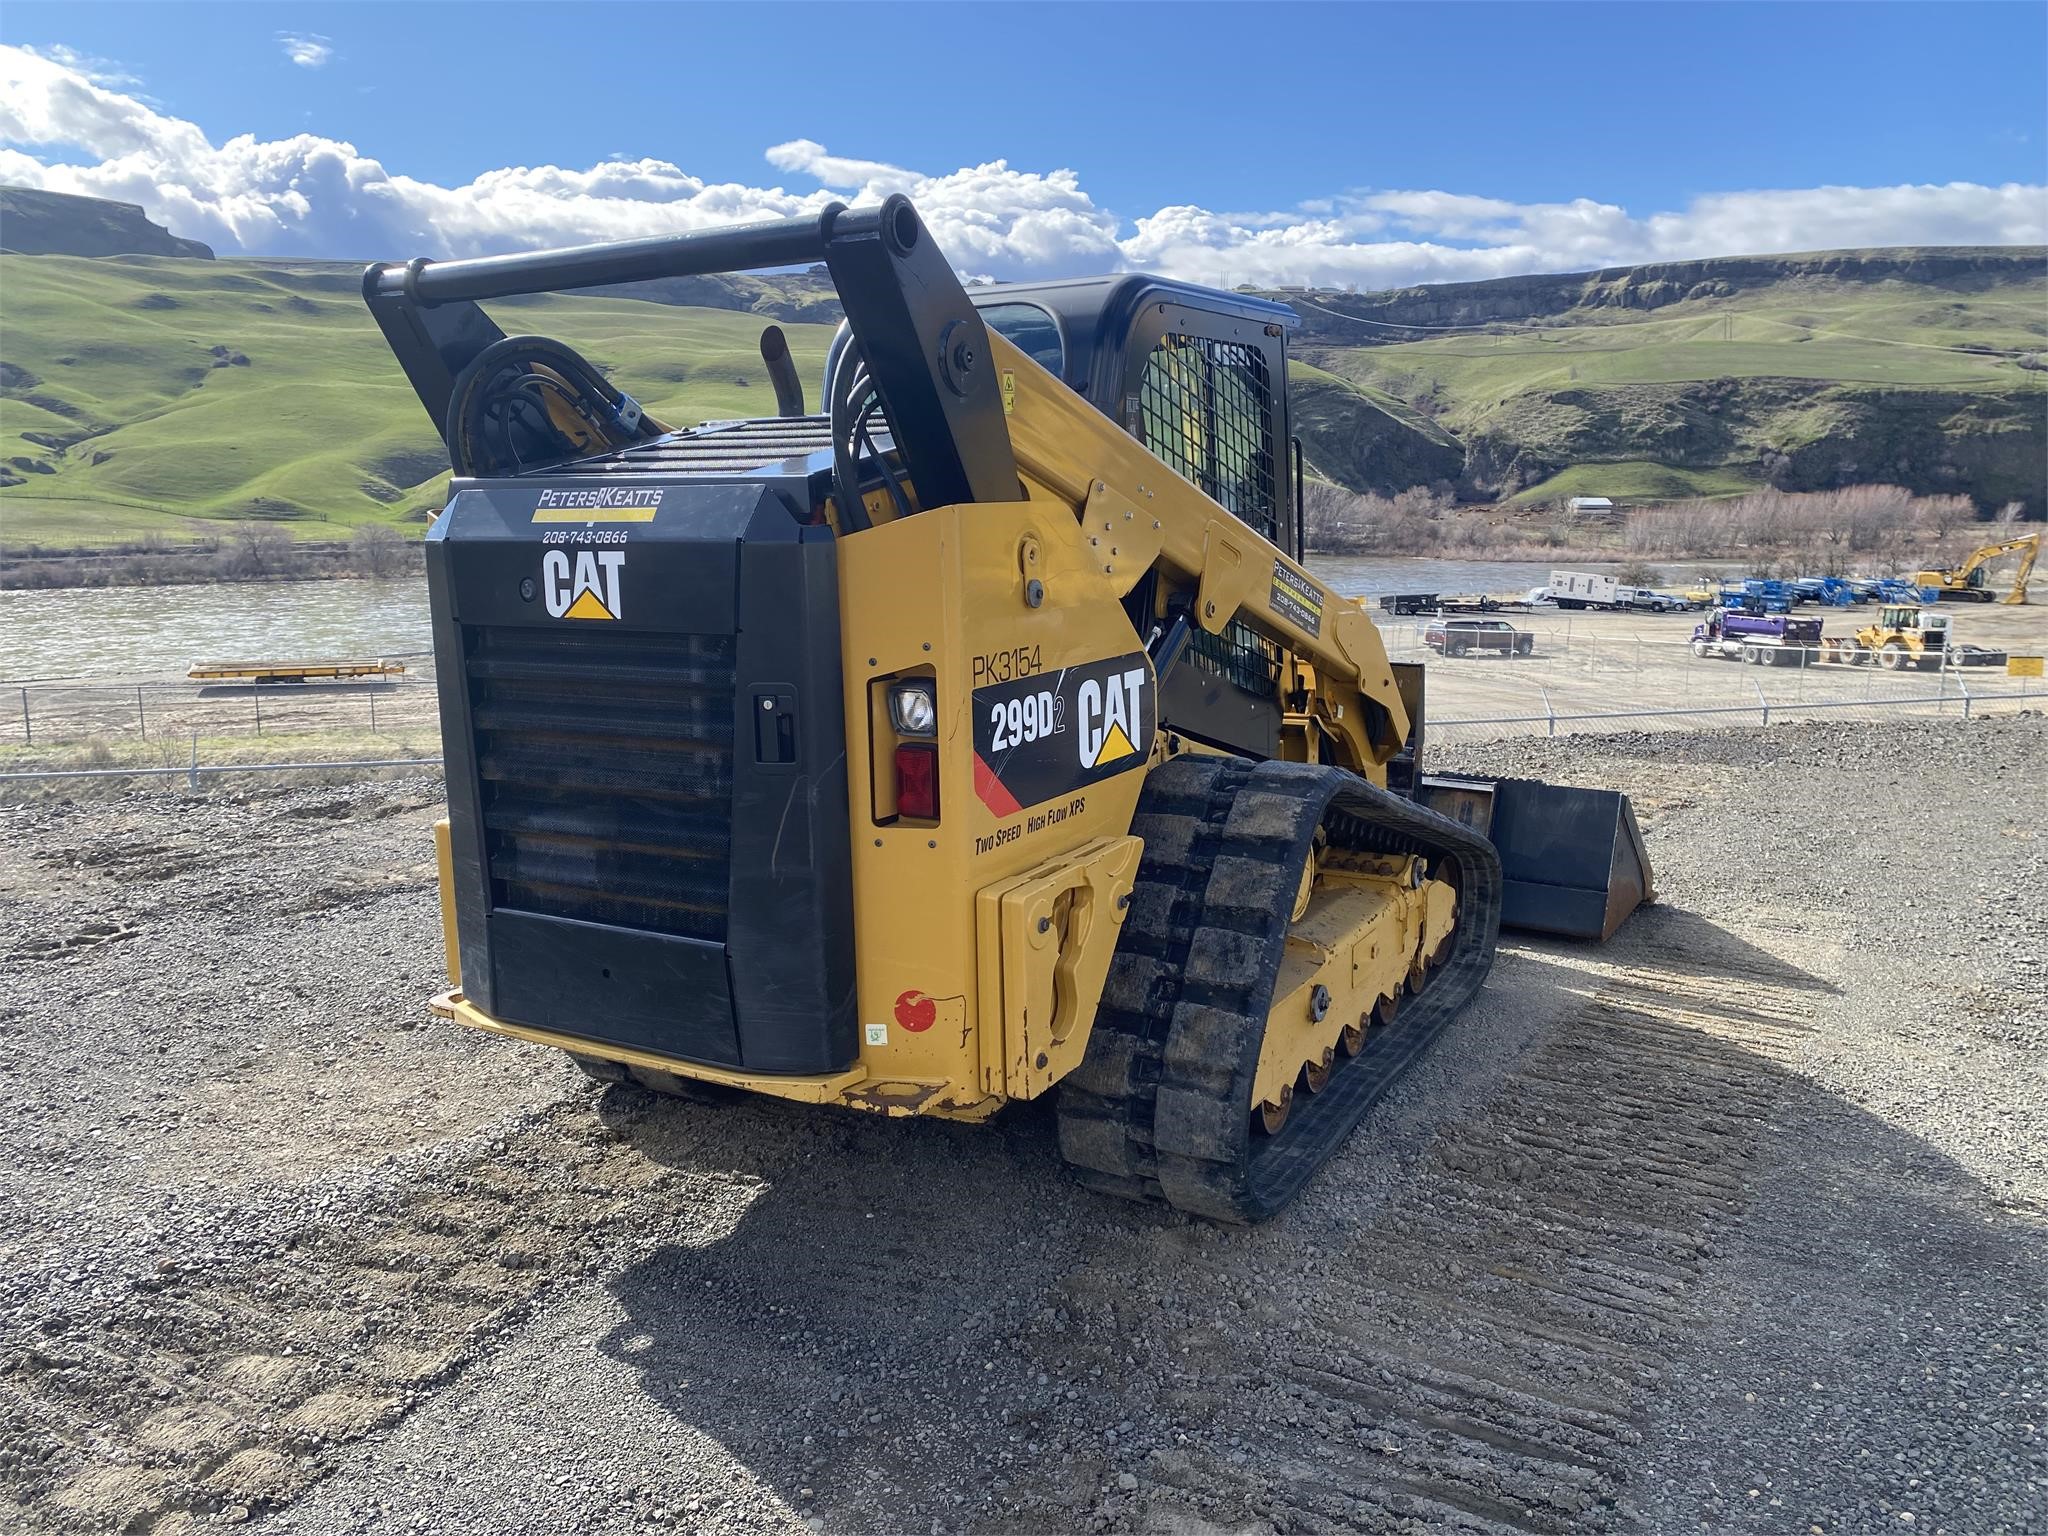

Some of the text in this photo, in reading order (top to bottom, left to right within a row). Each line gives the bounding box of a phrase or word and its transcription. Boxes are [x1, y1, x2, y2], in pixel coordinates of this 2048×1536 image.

[543, 549, 625, 620] CAT
[972, 644, 1043, 687] PK3154
[1078, 667, 1145, 769] CAT
[975, 796, 1086, 856] TWO SPEED HIGH FLOW XPS
